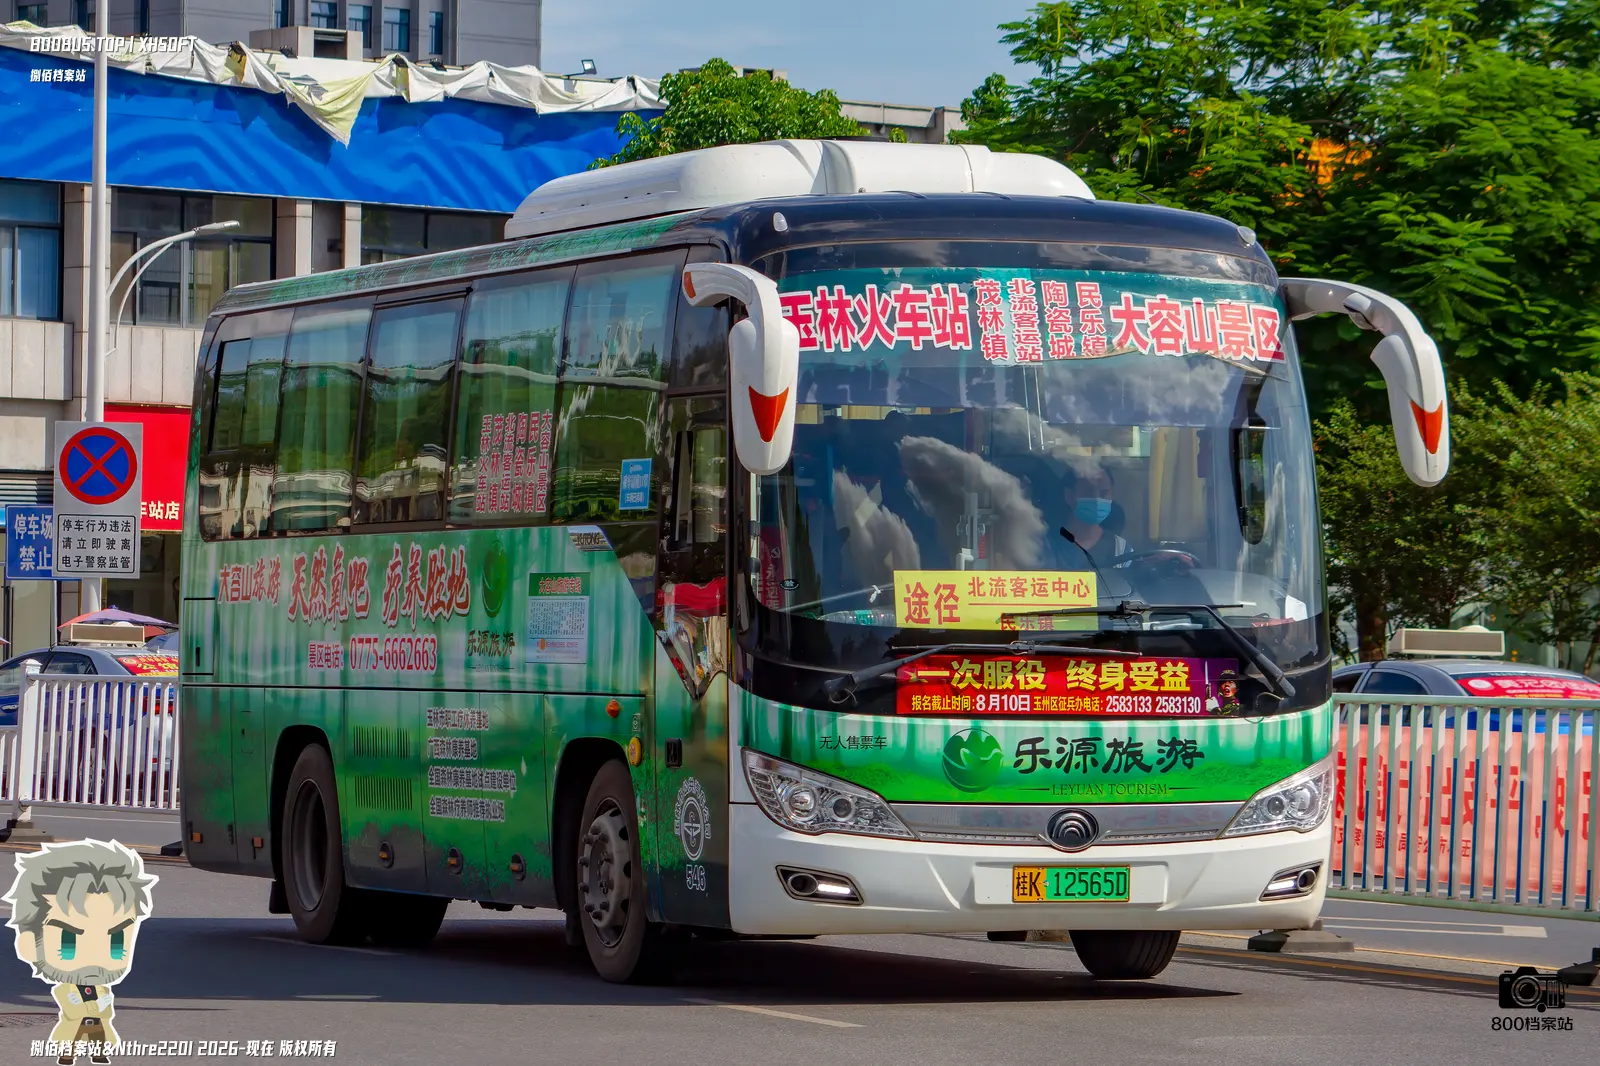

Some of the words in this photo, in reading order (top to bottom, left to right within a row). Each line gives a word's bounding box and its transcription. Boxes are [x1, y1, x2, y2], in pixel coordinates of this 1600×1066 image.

[779, 283, 972, 353] 玉林火车站
[973, 279, 1009, 361] 茂林镇
[1007, 278, 1042, 363] 北流客运站
[1042, 280, 1076, 360] 陶瓷城
[1075, 281, 1108, 358] 民乐镇
[1109, 292, 1287, 364] 大容山景区
[475, 414, 492, 514] 玉林火车站
[487, 413, 504, 514] 茂林镇
[499, 412, 517, 513] 北流客运站
[511, 411, 528, 513] 陶瓷城
[523, 410, 540, 513] 民乐镇
[535, 409, 553, 513] 大容山景区
[62, 519, 132, 533] 停车行为违法
[62, 537, 131, 551] 请立即驶离
[62, 555, 131, 569] 电子警察监管
[217, 554, 282, 606] 大容山旅游
[287, 541, 370, 631] 天然氧吧
[382, 540, 471, 631] 疗养胜地
[903, 581, 961, 625] 途径
[967, 576, 1091, 599] 北流客运中心
[308, 640, 344, 670] 景区电话:
[350, 636, 437, 672] 0775-6662663
[466, 630, 516, 658] 乐源旅游
[917, 658, 1047, 691] 一次服役
[1066, 660, 1191, 693] 终身受益
[1105, 695, 1152, 713] 2583133
[1155, 696, 1201, 714] 2583130
[427, 736, 478, 760] 广西森林康养基地
[819, 735, 888, 750] 无人售票车
[1013, 737, 1206, 775] 乐源旅游
[1052, 784, 1104, 796] LEYUAN
[1108, 783, 1167, 795] TOURISM
[686, 864, 707, 892] 546
[1015, 872, 1041, 897] 桂K
[1053, 871, 1128, 897] 12565D
